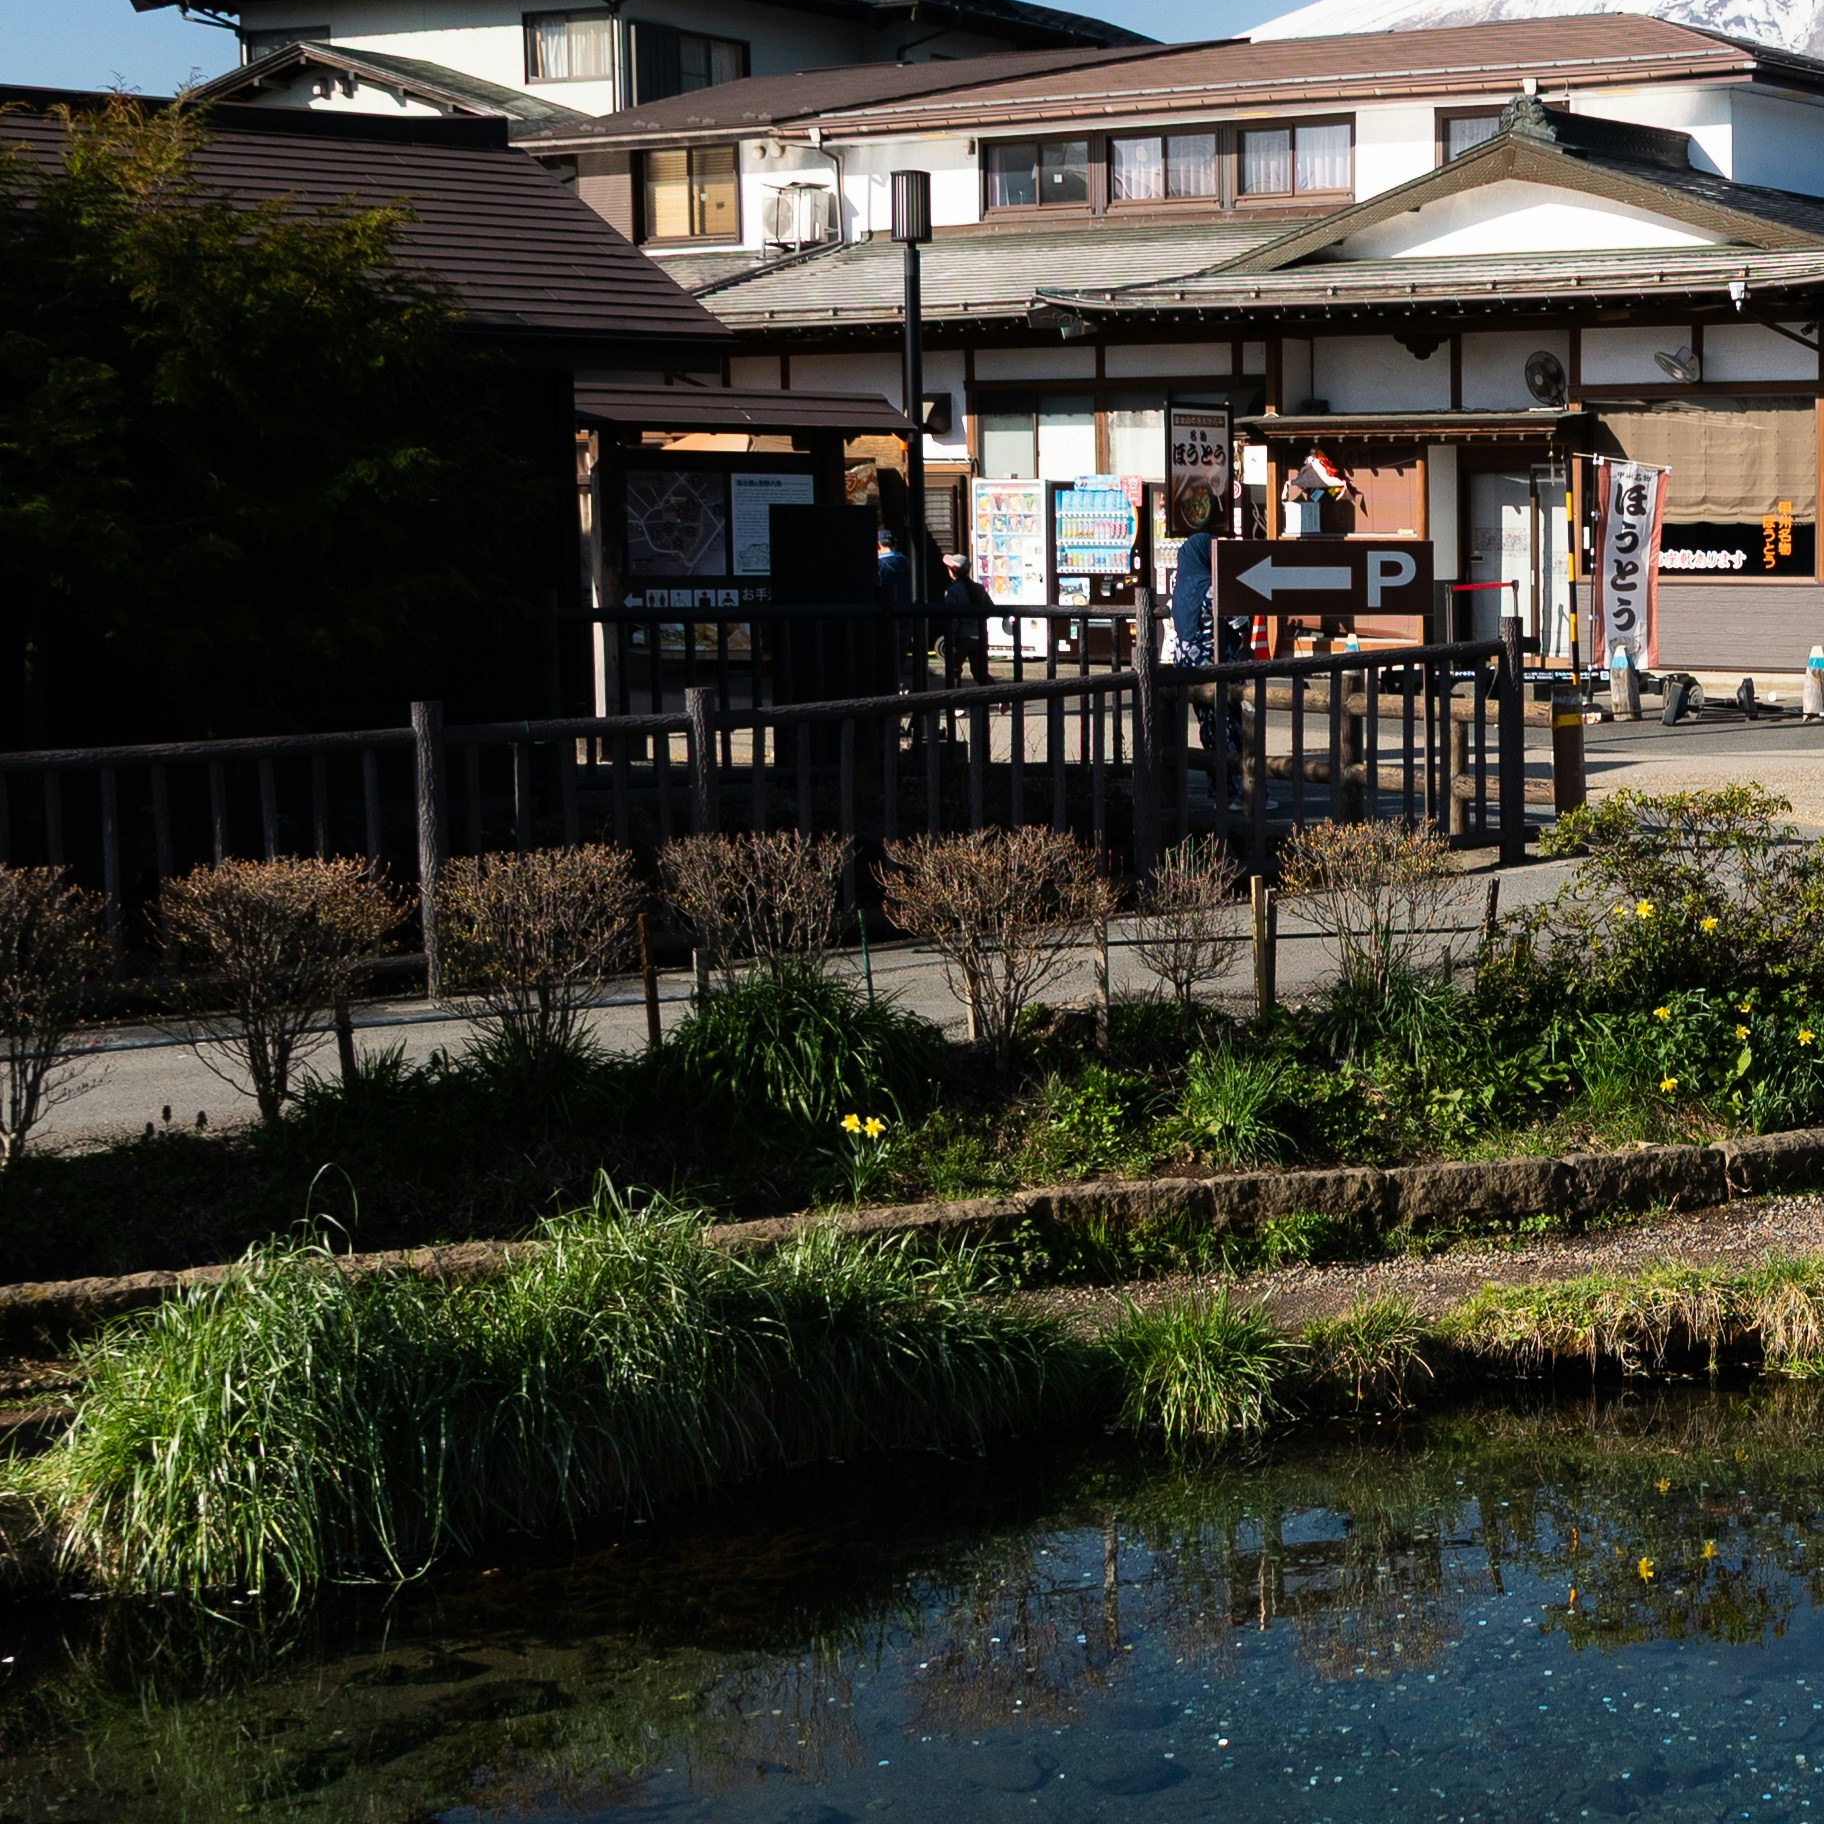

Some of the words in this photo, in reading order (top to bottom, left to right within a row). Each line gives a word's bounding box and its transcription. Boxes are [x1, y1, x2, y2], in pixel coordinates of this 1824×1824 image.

[1172, 442, 1226, 467] ほうとう
[1762, 514, 1776, 569] ほうとう
[1778, 501, 1792, 556] 甲州名物
[1366, 551, 1417, 608] P
[1610, 482, 1648, 632] ほうとう
